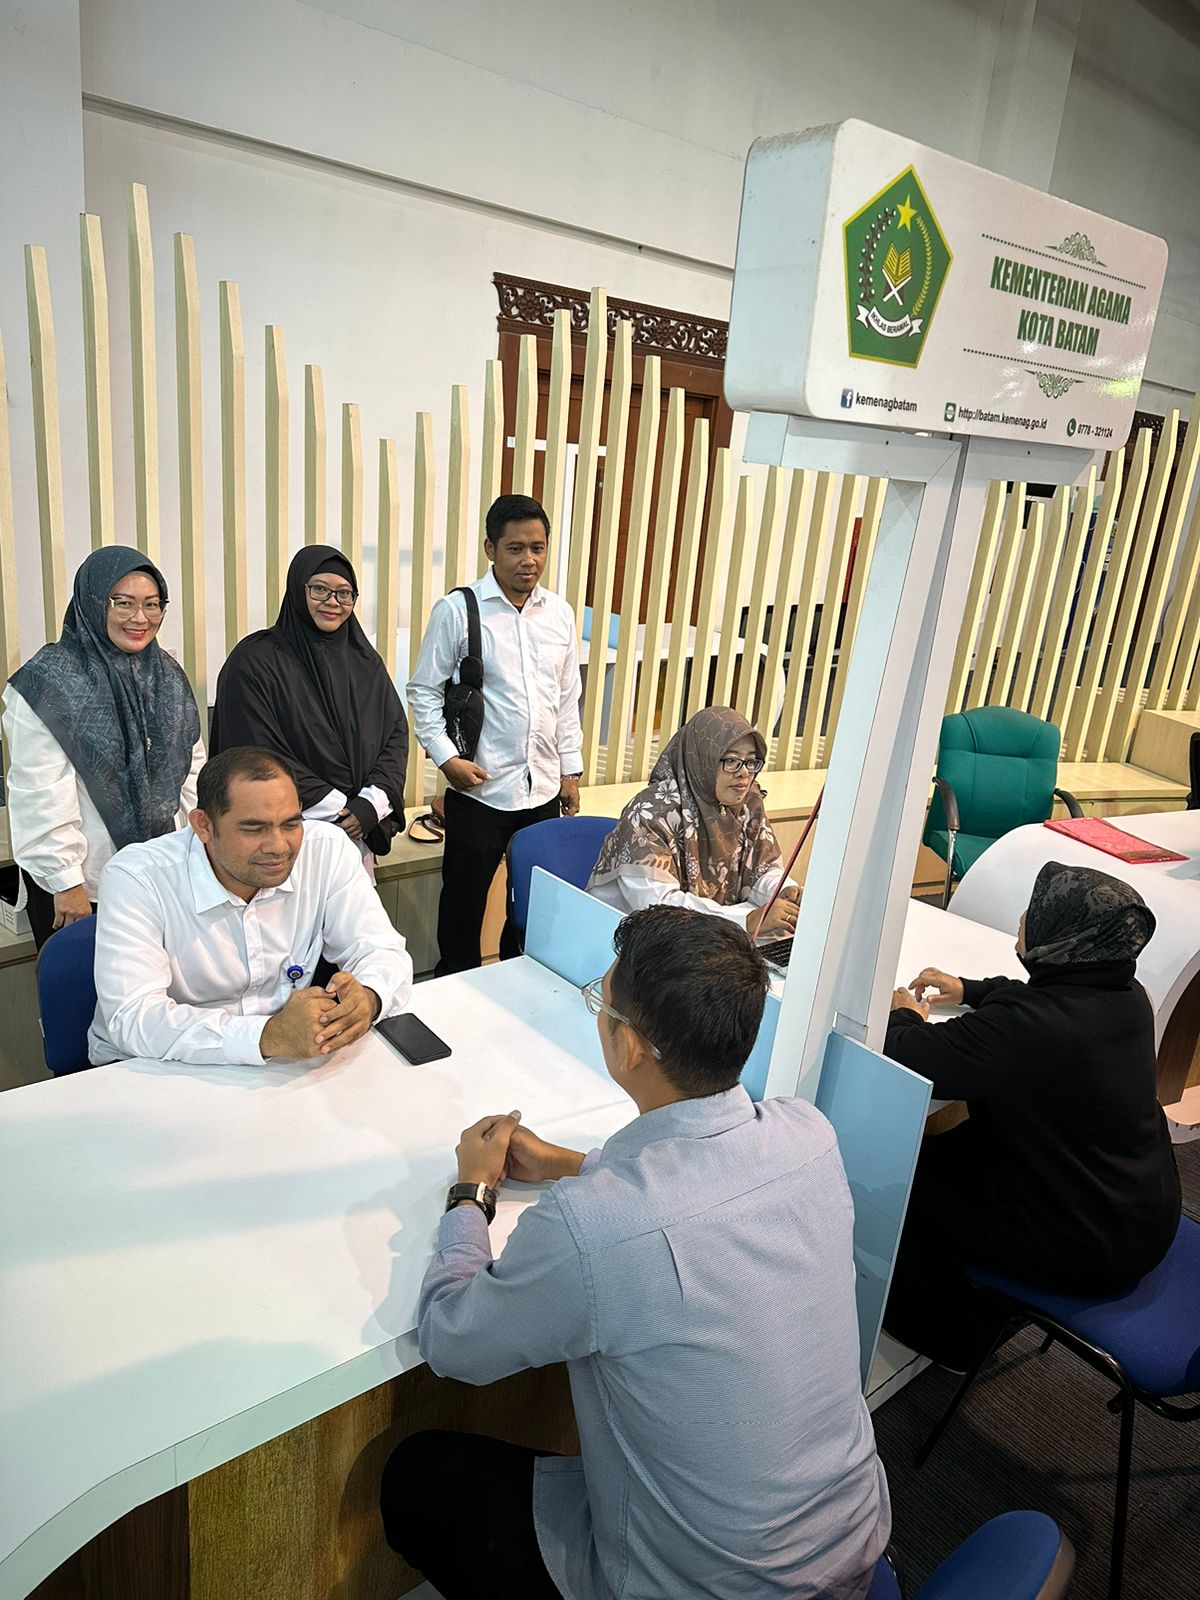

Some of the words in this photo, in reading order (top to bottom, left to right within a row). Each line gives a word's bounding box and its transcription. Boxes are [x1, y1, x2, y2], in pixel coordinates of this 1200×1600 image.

[990, 255, 1089, 313] KEMENTERIAN
[1086, 286, 1132, 325] AGAMA
[1017, 308, 1055, 347] KOTA
[1054, 318, 1100, 357] BATAM
[855, 392, 918, 412] kemenagbatam
[957, 406, 1048, 430] http://batam.kemenag.go.id
